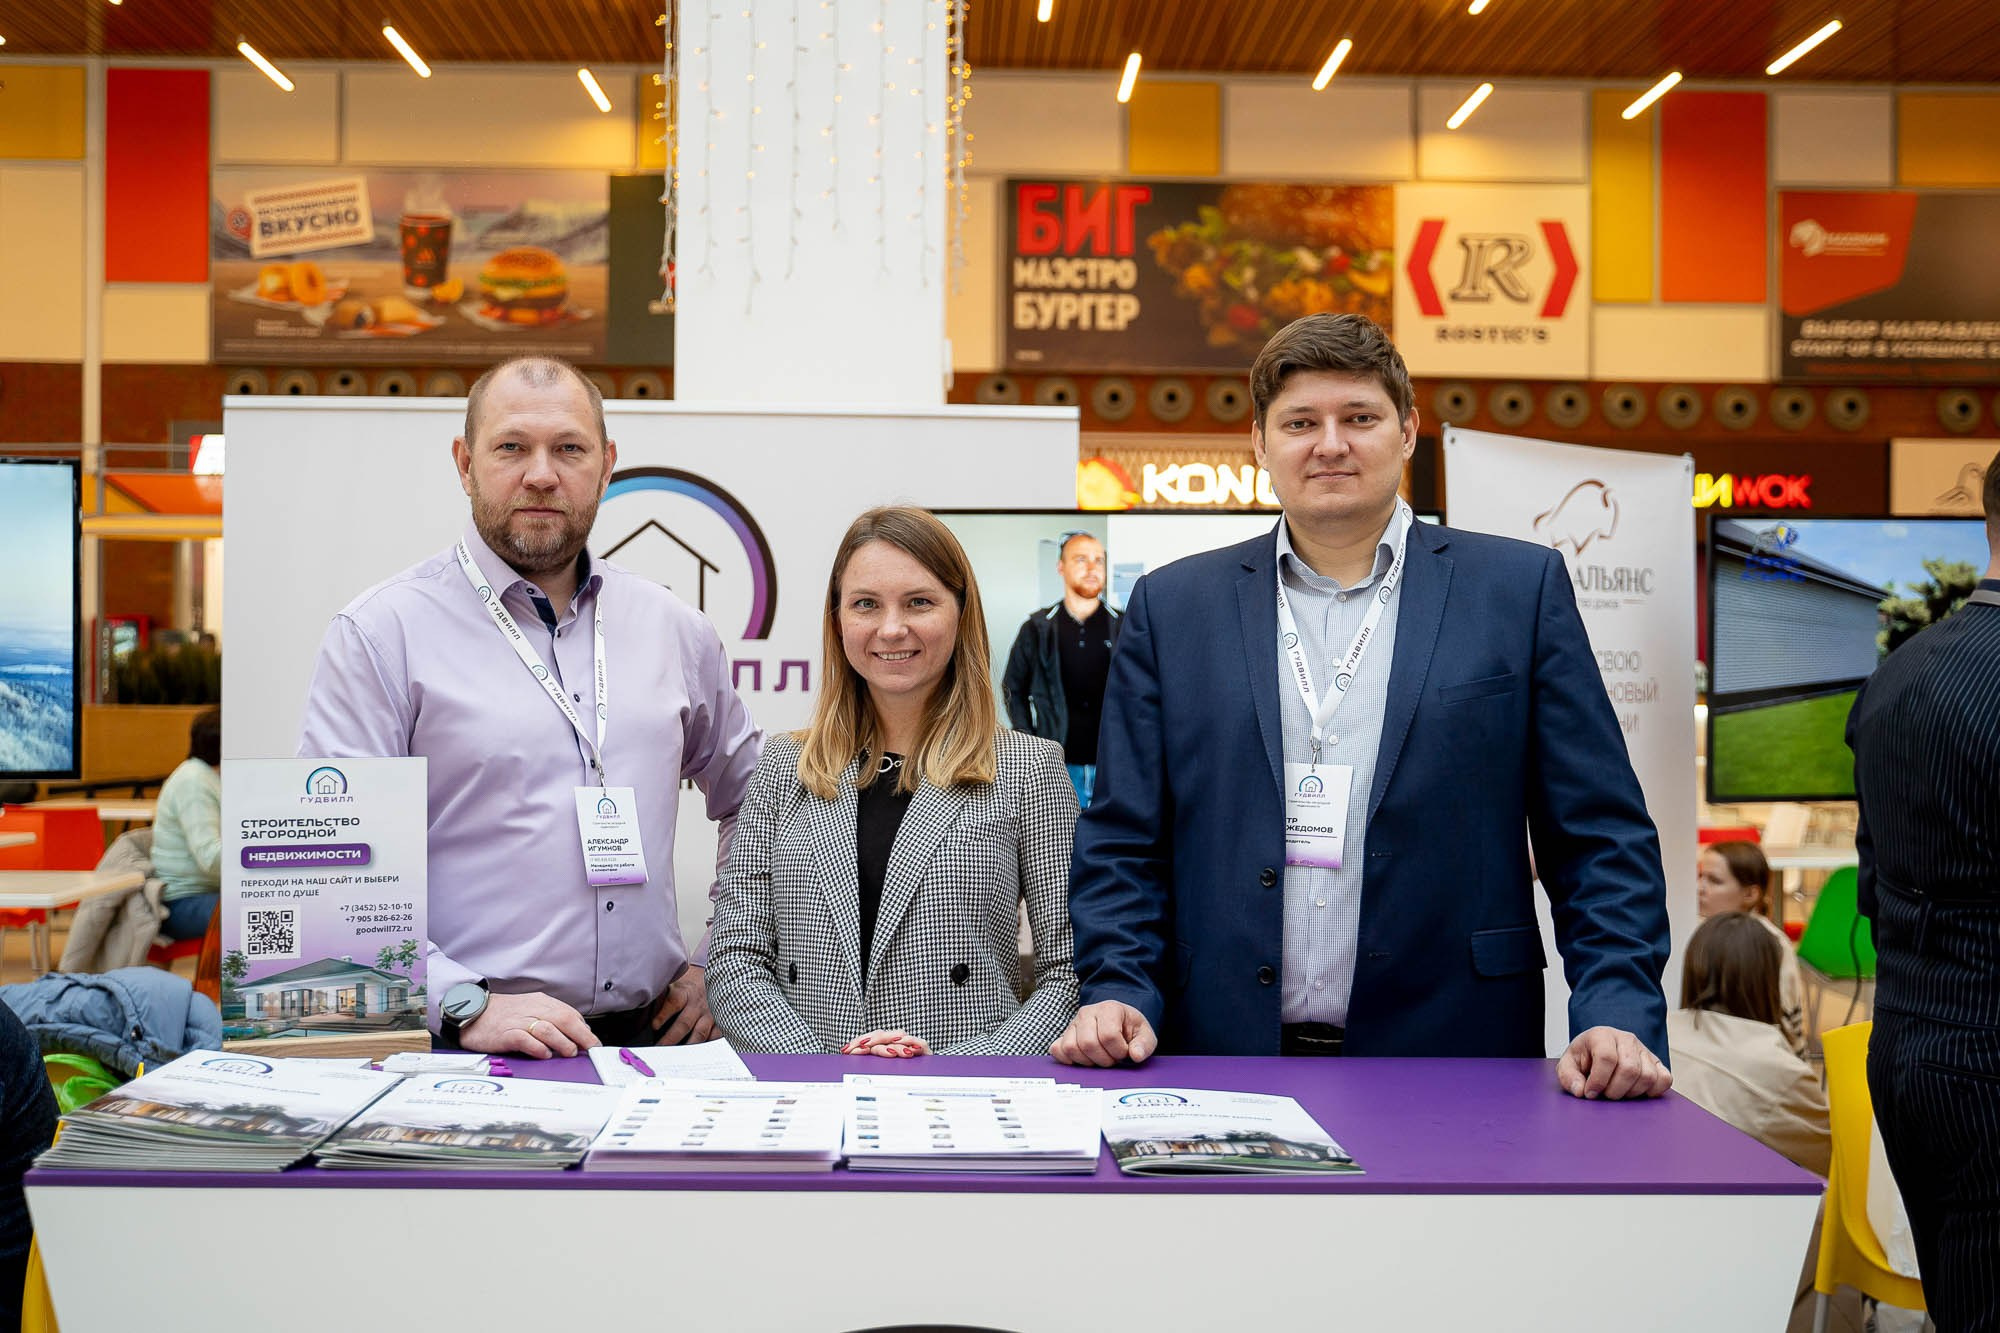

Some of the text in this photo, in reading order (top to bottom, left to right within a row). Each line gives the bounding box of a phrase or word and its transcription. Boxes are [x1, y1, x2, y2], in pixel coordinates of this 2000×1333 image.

[258, 209, 359, 237] ВКУСНО
[1017, 184, 1152, 258] БИГ
[1012, 257, 1138, 290] МАЭСТРО
[1012, 292, 1141, 331] БУРГЕР
[1436, 326, 1549, 342] ROSTIC'S
[1574, 565, 1655, 596] АЛЬЯНС
[490, 601, 521, 640] ГУДВИЛЛ
[1346, 627, 1371, 670] ГУДВИЛЛ
[1292, 651, 1310, 693] ГУДВИЛЛ
[548, 681, 577, 722] ГУДВИЛЛ
[300, 796, 354, 804] ГУДВИЛЛ
[241, 817, 360, 828] СТРОИТЕЛЬСТВО
[1286, 825, 1333, 833] ЖЕДОМОВ
[241, 827, 337, 839] ЗАГОРОДНОЙ
[249, 850, 361, 862] НЕДВИЖИМОСТИ
[241, 879, 289, 888] ПЕРЕХОДИ
[291, 878, 304, 886] НА
[306, 877, 327, 885] НАШ
[330, 876, 352, 885] САЙТ
[364, 875, 399, 883] ВЫБЕРИ
[278, 890, 291, 898] ПО
[293, 889, 320, 898] ДУШЕ
[340, 902, 413, 913] +7 (3452) 52-10-10
[345, 914, 413, 923] +7 905 826-62-26
[355, 925, 413, 935] goodwill72.ru
